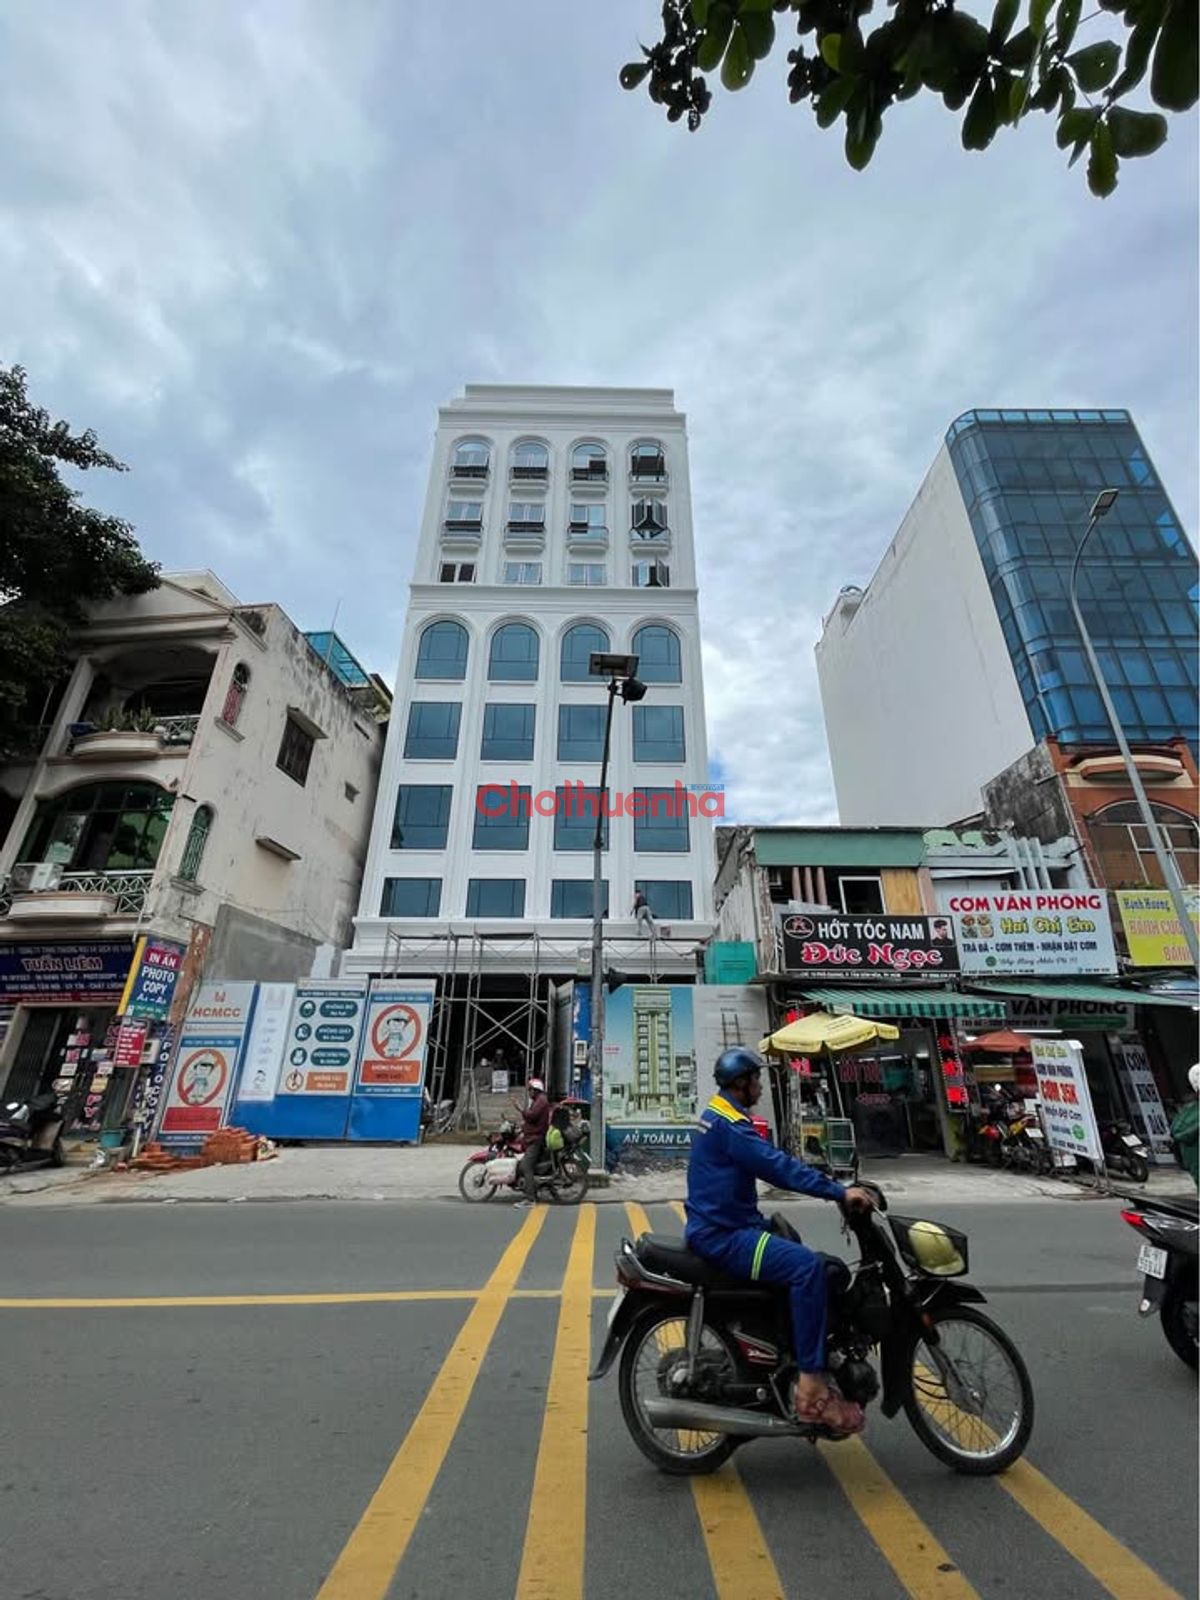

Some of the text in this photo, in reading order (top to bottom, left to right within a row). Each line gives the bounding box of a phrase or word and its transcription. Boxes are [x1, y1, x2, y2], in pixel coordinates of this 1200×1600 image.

[817, 918, 925, 940] HỚT TÓC NAM
[867, 942, 943, 969] Ngọc
[142, 966, 175, 983] PHOTO
[144, 980, 168, 995] COPY
[192, 1007, 241, 1018] HCMCC
[642, 1130, 674, 1144] TOÀN
